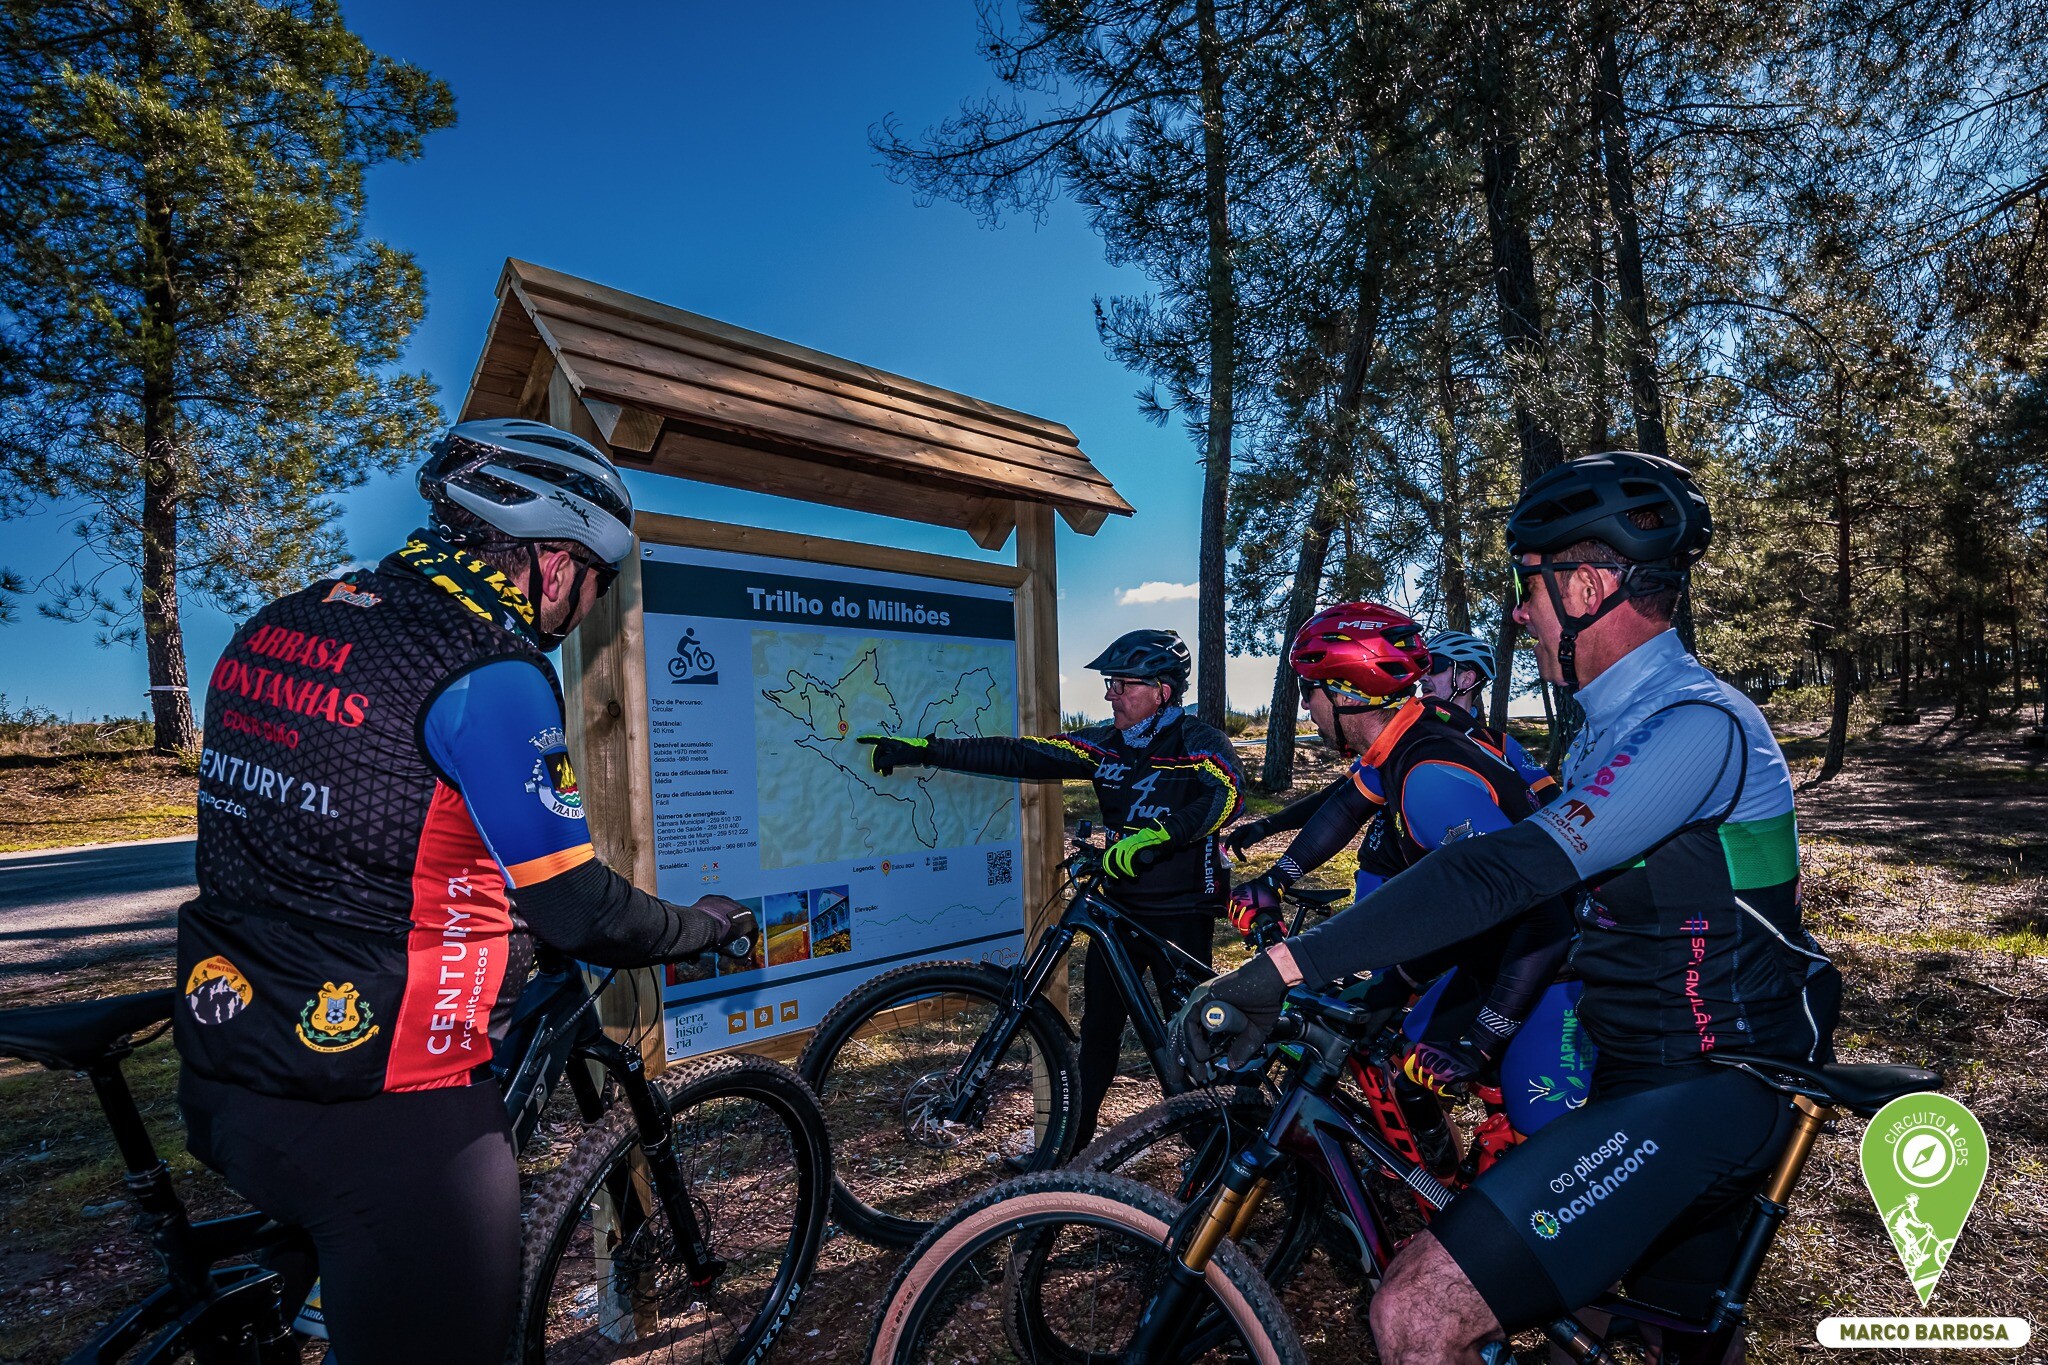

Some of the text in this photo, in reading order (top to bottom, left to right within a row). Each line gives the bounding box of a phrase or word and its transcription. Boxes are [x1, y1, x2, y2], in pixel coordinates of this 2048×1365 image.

[549, 490, 590, 528] Spiuk
[746, 586, 951, 627] Trilho do Milhões
[1337, 620, 1388, 630] MET
[244, 624, 353, 674] ARRASA
[199, 748, 295, 803] ENTURY
[551, 801, 570, 817] VILA
[571, 809, 580, 818] DO
[656, 820, 679, 828] Câmara
[679, 818, 706, 826] Municipal
[1541, 807, 1589, 852] ortaleza
[657, 834, 687, 842] Bombeiros
[696, 845, 722, 853] Municipal
[658, 862, 690, 870] Sinalética:
[852, 864, 876, 873] Legenda:
[1204, 834, 1215, 894] FULLBIKE
[854, 905, 879, 913] Elevação:
[427, 905, 472, 1056] CENTURY
[460, 946, 489, 1051] Arquitectos
[673, 1012, 704, 1027] Terra
[1560, 1008, 1578, 1071] JARDINS
[676, 1038, 692, 1050] ria
[1060, 1070, 1070, 1112] BUTCHER
[1574, 1130, 1629, 1182] pitosga
[1557, 1139, 1660, 1224] acvâncora
[746, 1282, 802, 1365] MAXXIS
